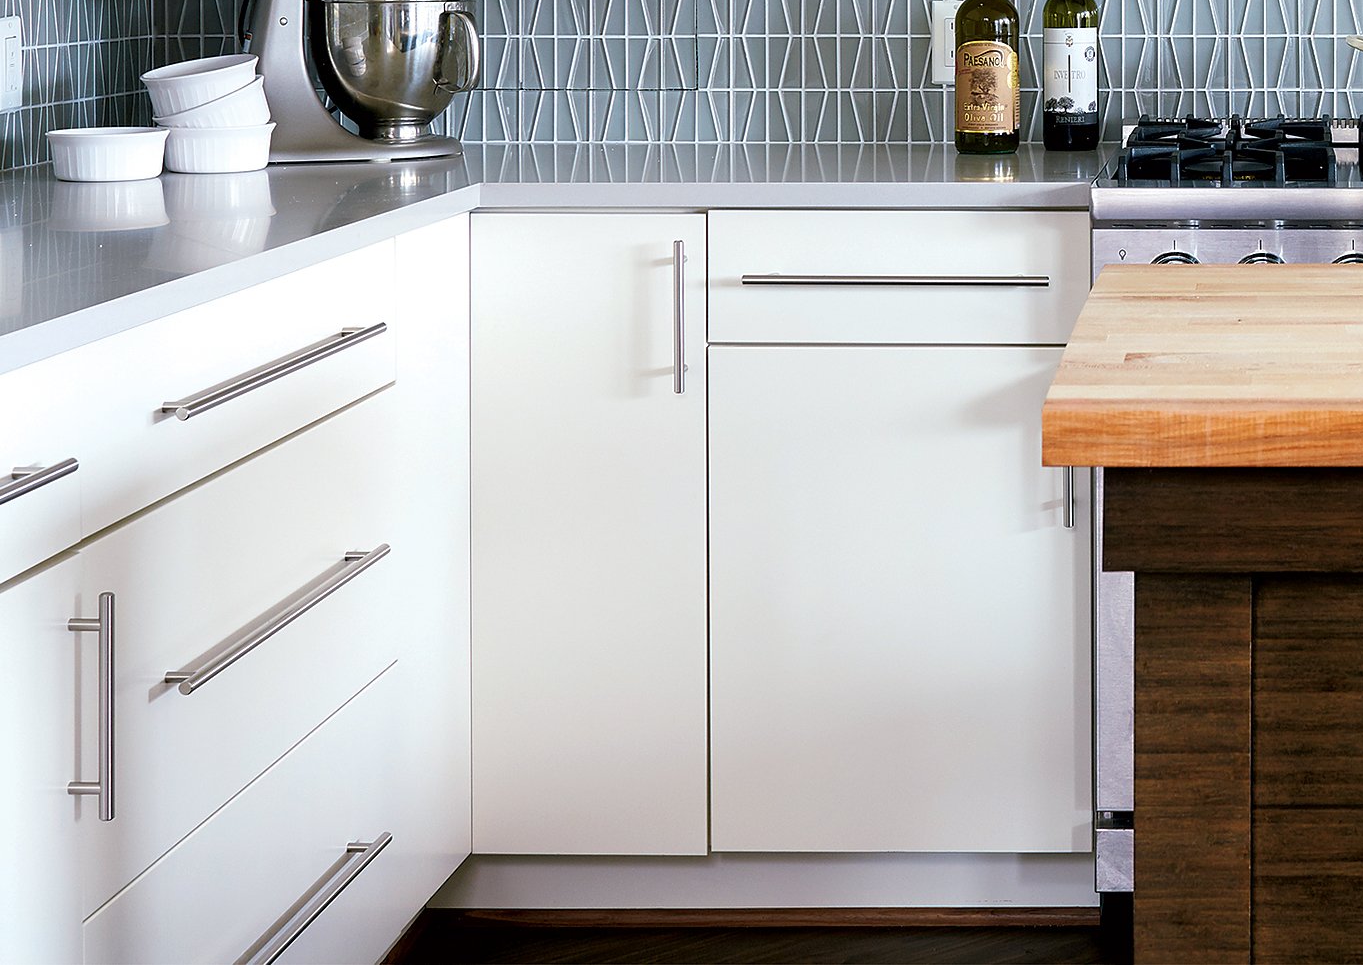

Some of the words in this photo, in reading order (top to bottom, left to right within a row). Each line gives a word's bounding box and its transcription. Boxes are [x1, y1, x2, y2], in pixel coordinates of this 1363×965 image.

[963, 52, 1001, 66] PAESANO
[964, 102, 981, 111] Extra
[981, 102, 1005, 113] Virgin
[964, 113, 986, 122] Olive
[990, 113, 1004, 122] Oil
[1055, 115, 1086, 124] RENIERI
